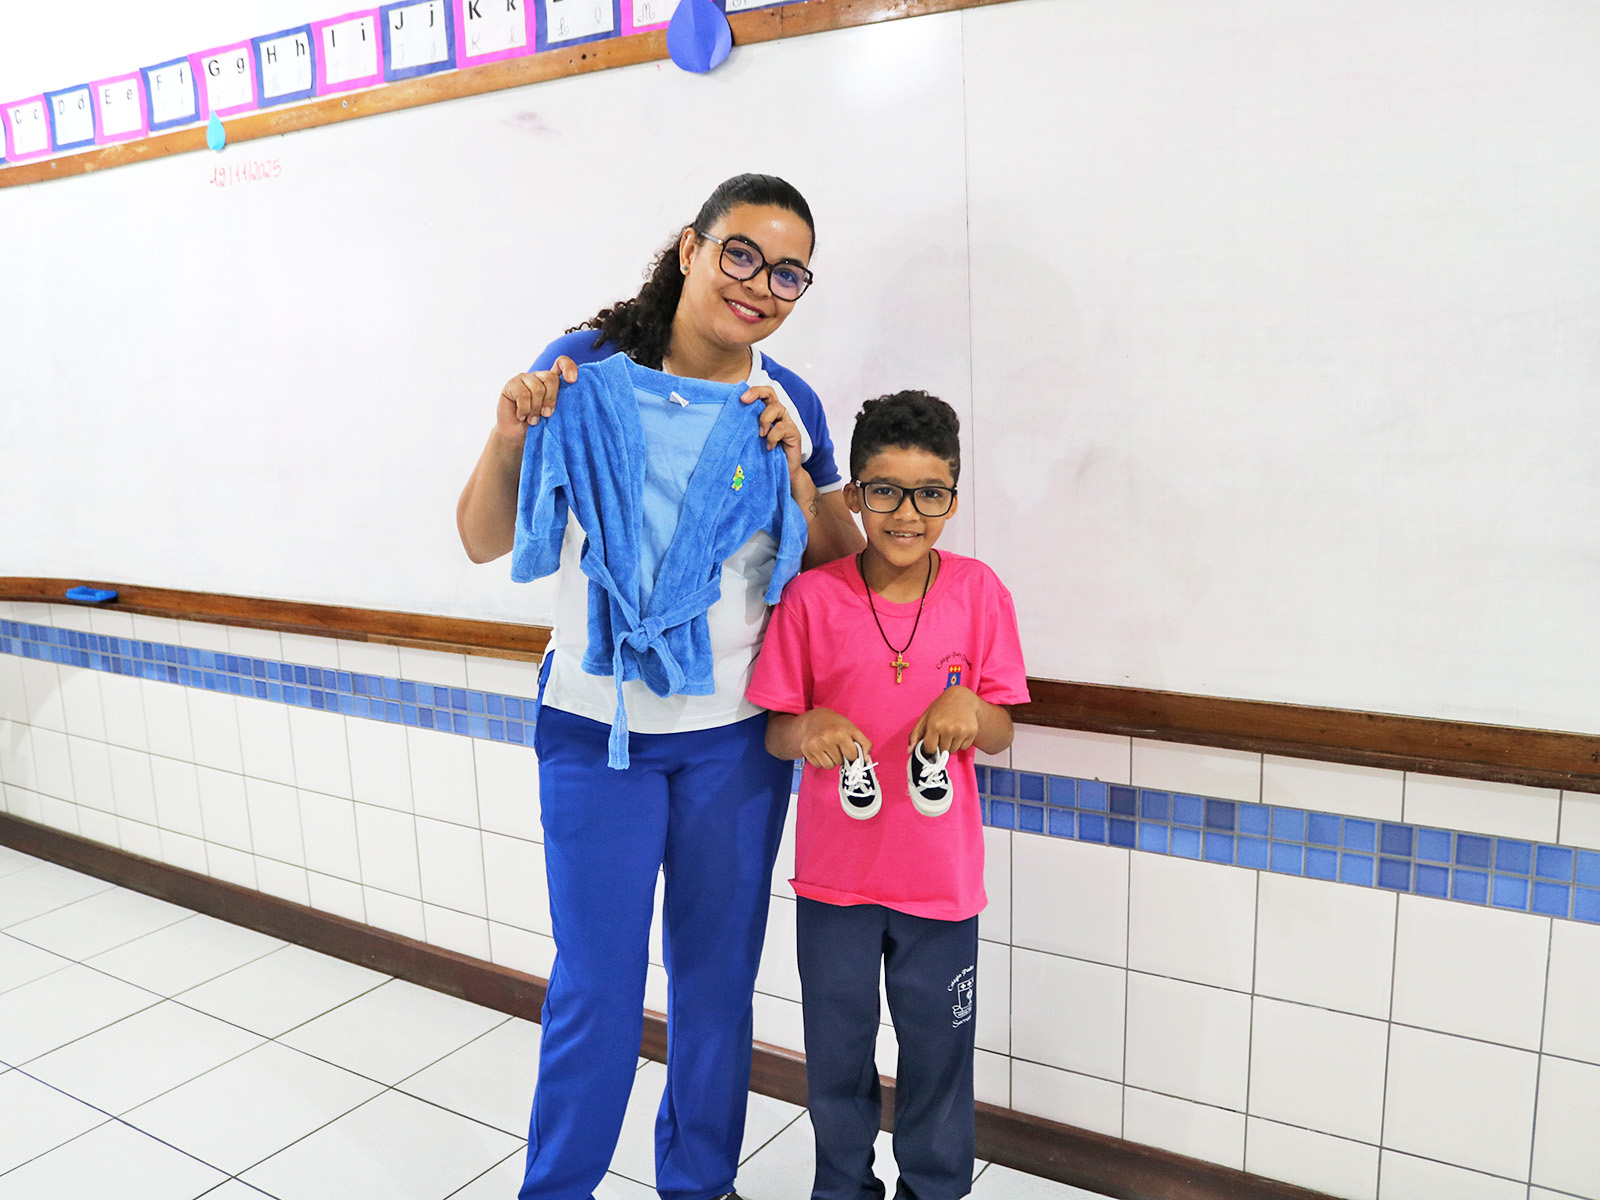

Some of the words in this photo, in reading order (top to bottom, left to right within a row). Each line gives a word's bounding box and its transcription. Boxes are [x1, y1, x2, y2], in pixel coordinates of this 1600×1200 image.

[394, 11, 404, 30] J
[429, 4, 435, 28] j
[467, 0, 482, 20] K
[331, 29, 336, 48] I
[360, 22, 366, 41] i
[266, 44, 278, 65] H
[295, 38, 306, 57] h
[208, 59, 221, 77] G
[236, 57, 246, 74] g
[156, 74, 163, 91] F
[59, 99, 66, 115] D
[77, 93, 85, 110] d
[104, 88, 113, 105] E
[126, 88, 133, 101] e
[14, 109, 22, 125] C
[33, 108, 40, 121] c
[209, 157, 282, 188] 12/11/2025
